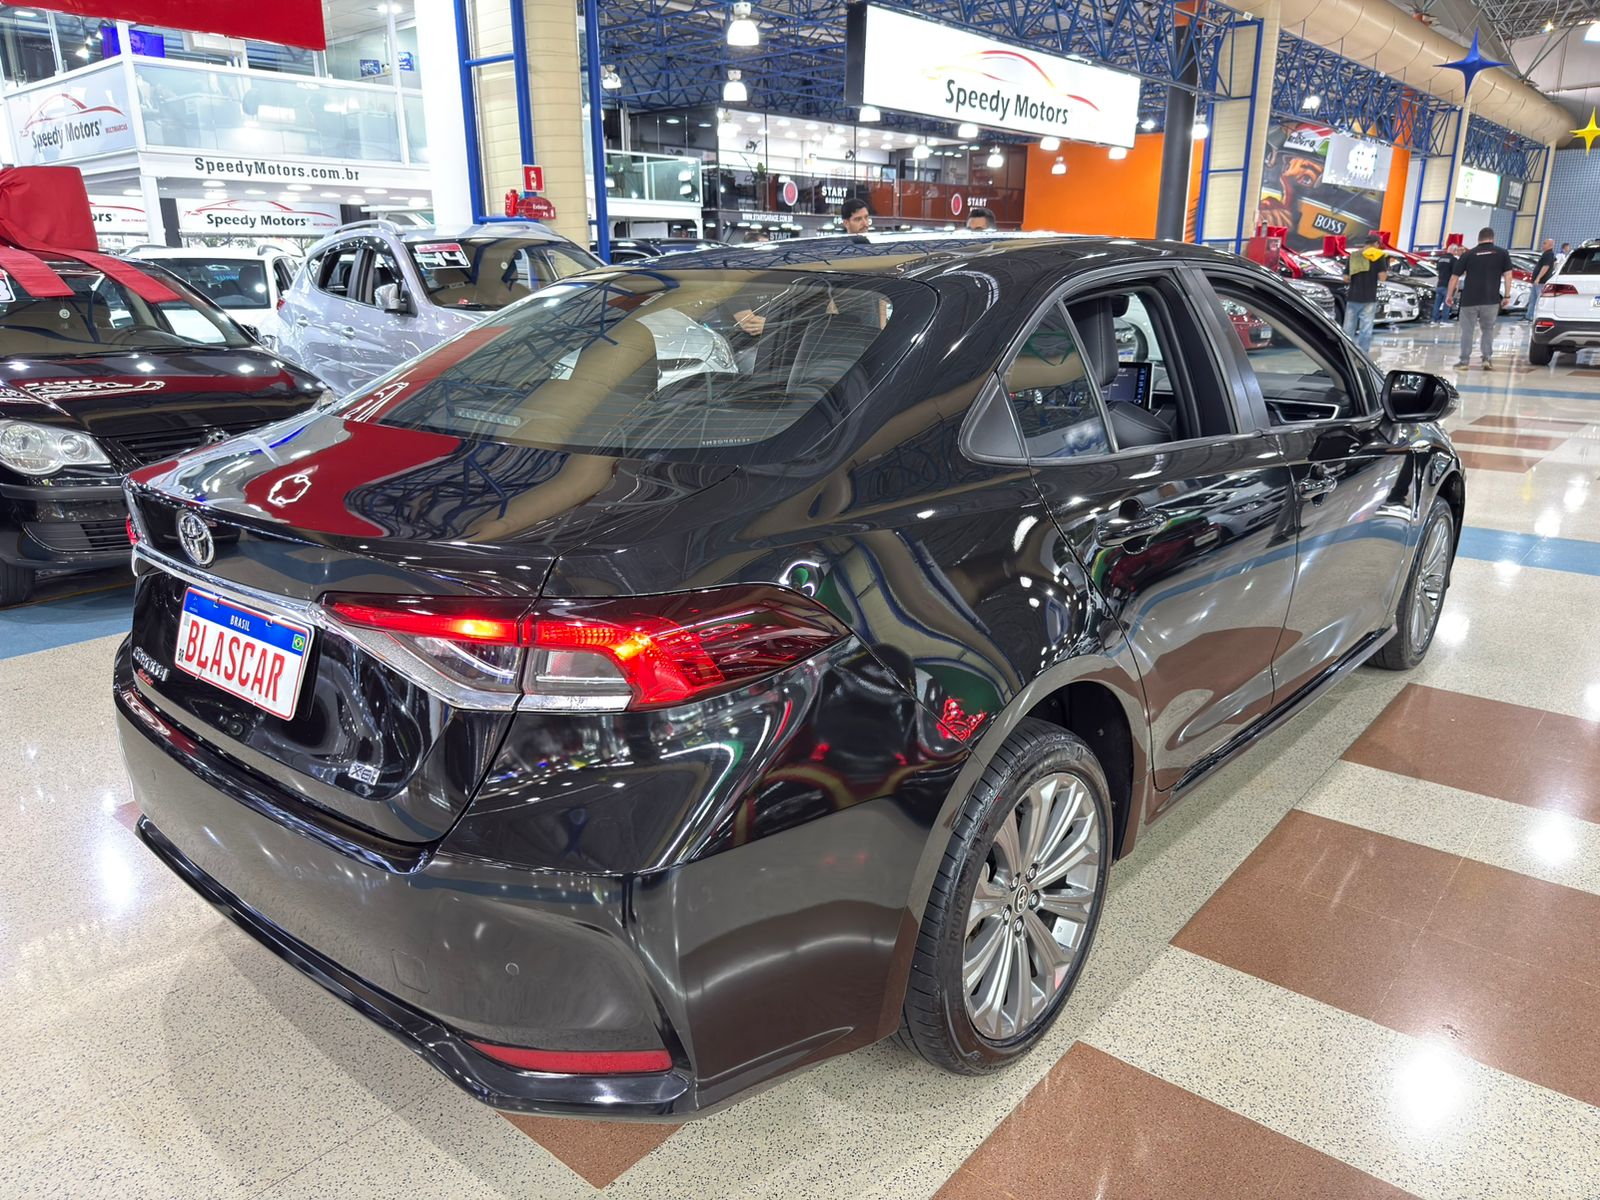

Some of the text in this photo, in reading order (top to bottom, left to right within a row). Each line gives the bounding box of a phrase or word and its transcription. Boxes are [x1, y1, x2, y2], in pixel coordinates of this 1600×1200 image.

[945, 79, 1068, 125] Speedy Motors
[31, 119, 100, 153] Speedy Motors
[194, 157, 360, 181] SpeedyMotors.com.br
[821, 186, 848, 198] START
[967, 197, 987, 207] START
[206, 213, 307, 228] Speedy Motors
[1314, 214, 1344, 234] BOSS
[229, 614, 251, 632] BRASIL
[184, 619, 285, 702] BLASCAR
